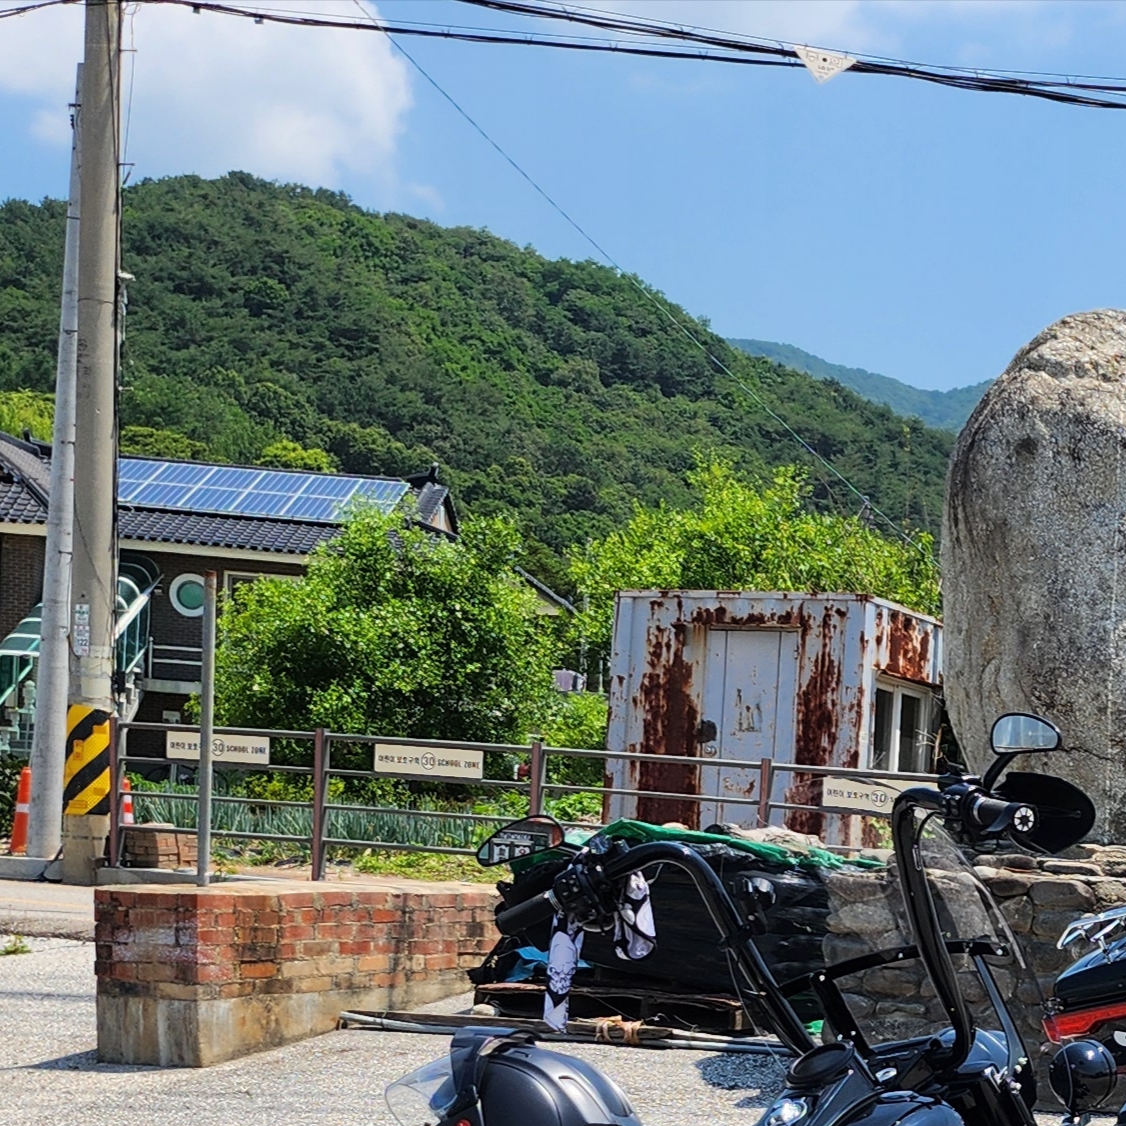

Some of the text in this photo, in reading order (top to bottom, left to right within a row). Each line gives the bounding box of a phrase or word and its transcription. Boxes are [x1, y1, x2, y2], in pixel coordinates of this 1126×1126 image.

[170, 741, 185, 749] 어린이
[226, 745, 249, 753] SCHOOL
[378, 754, 421, 765] 어린이 보호구역
[437, 758, 480, 769] SCHOOL ZONE
[827, 788, 870, 801] 어린이 보호구역
